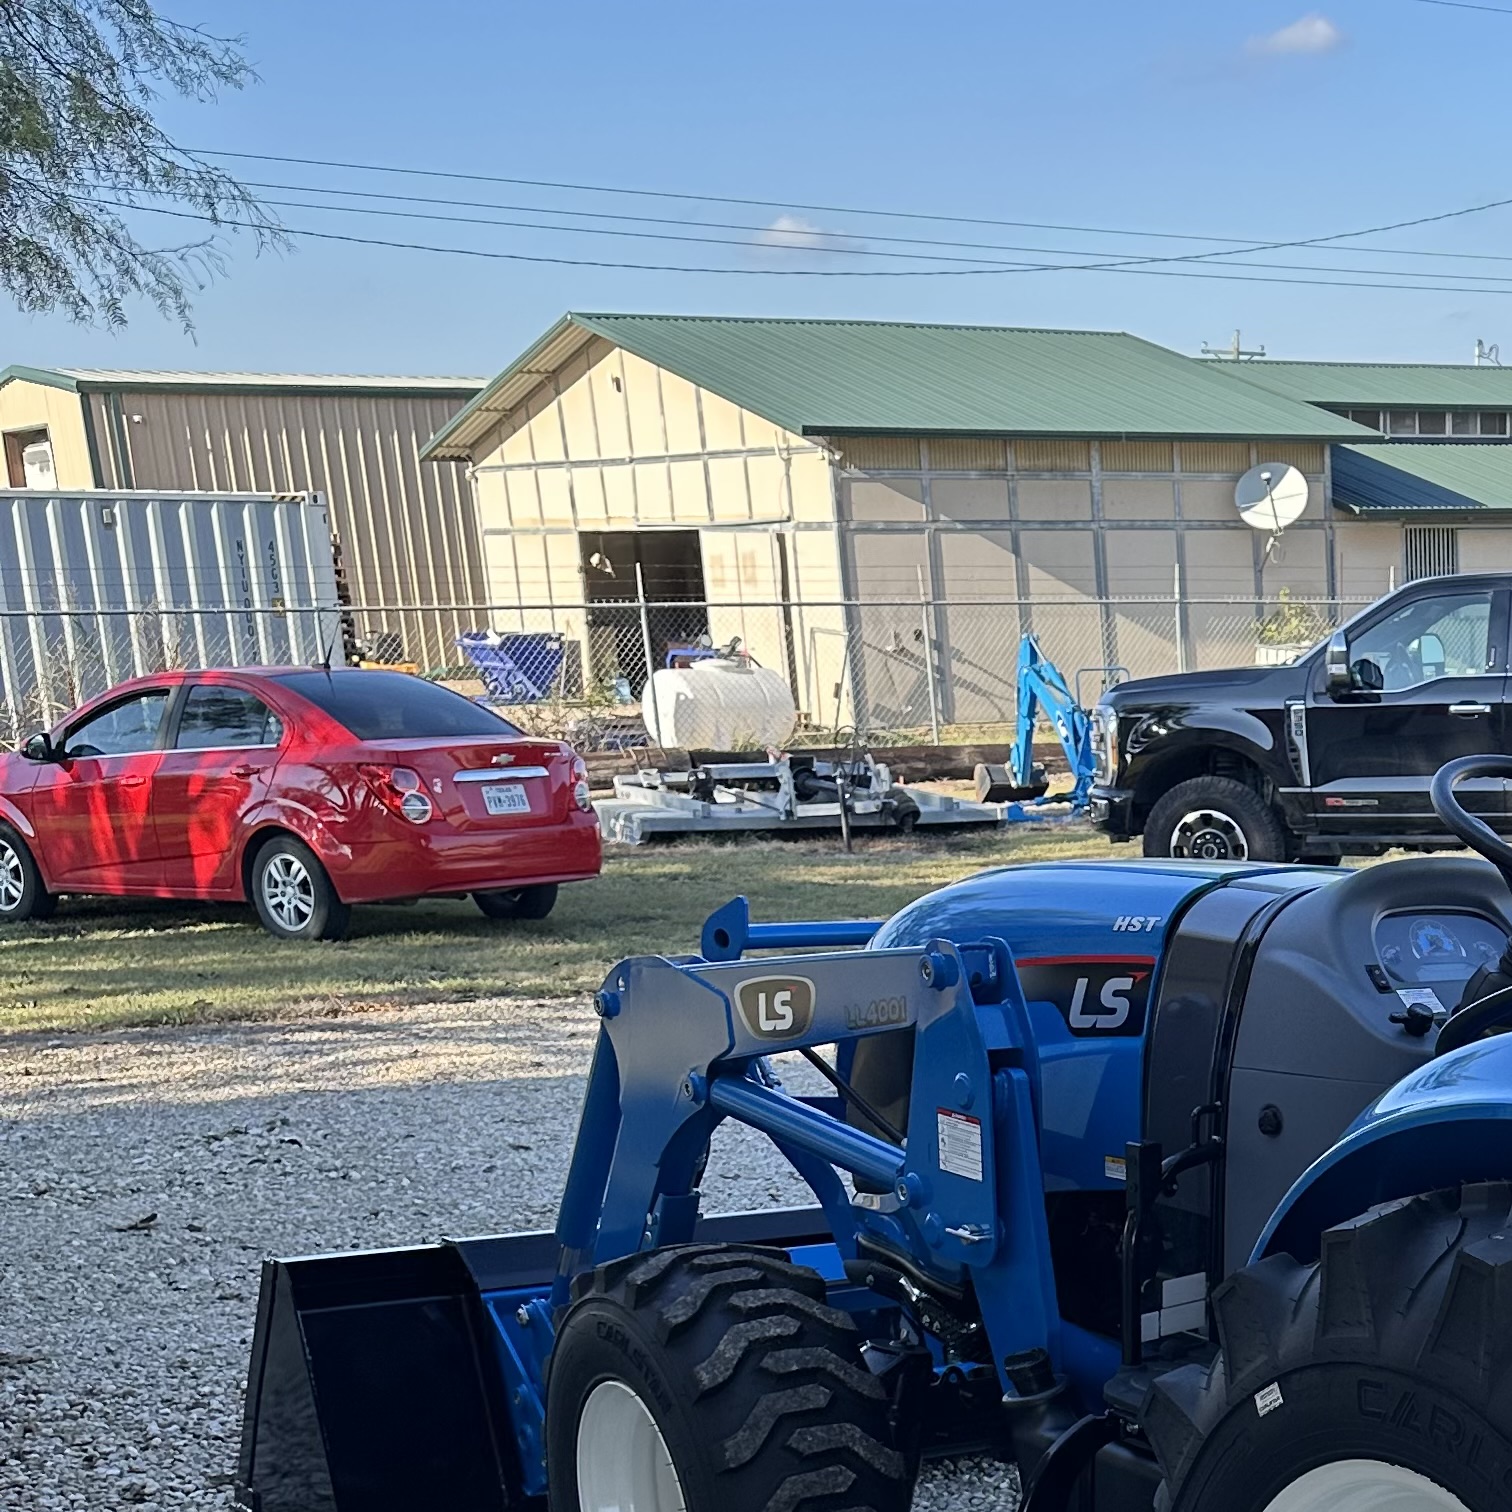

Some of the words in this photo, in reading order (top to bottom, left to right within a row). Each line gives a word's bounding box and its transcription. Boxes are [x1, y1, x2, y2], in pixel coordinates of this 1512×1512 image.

[236, 540, 249, 592] NYIU
[1112, 915, 1162, 933] HST
[758, 990, 795, 1031] LS
[844, 995, 907, 1030] LL4001
[1069, 976, 1134, 1030] LS
